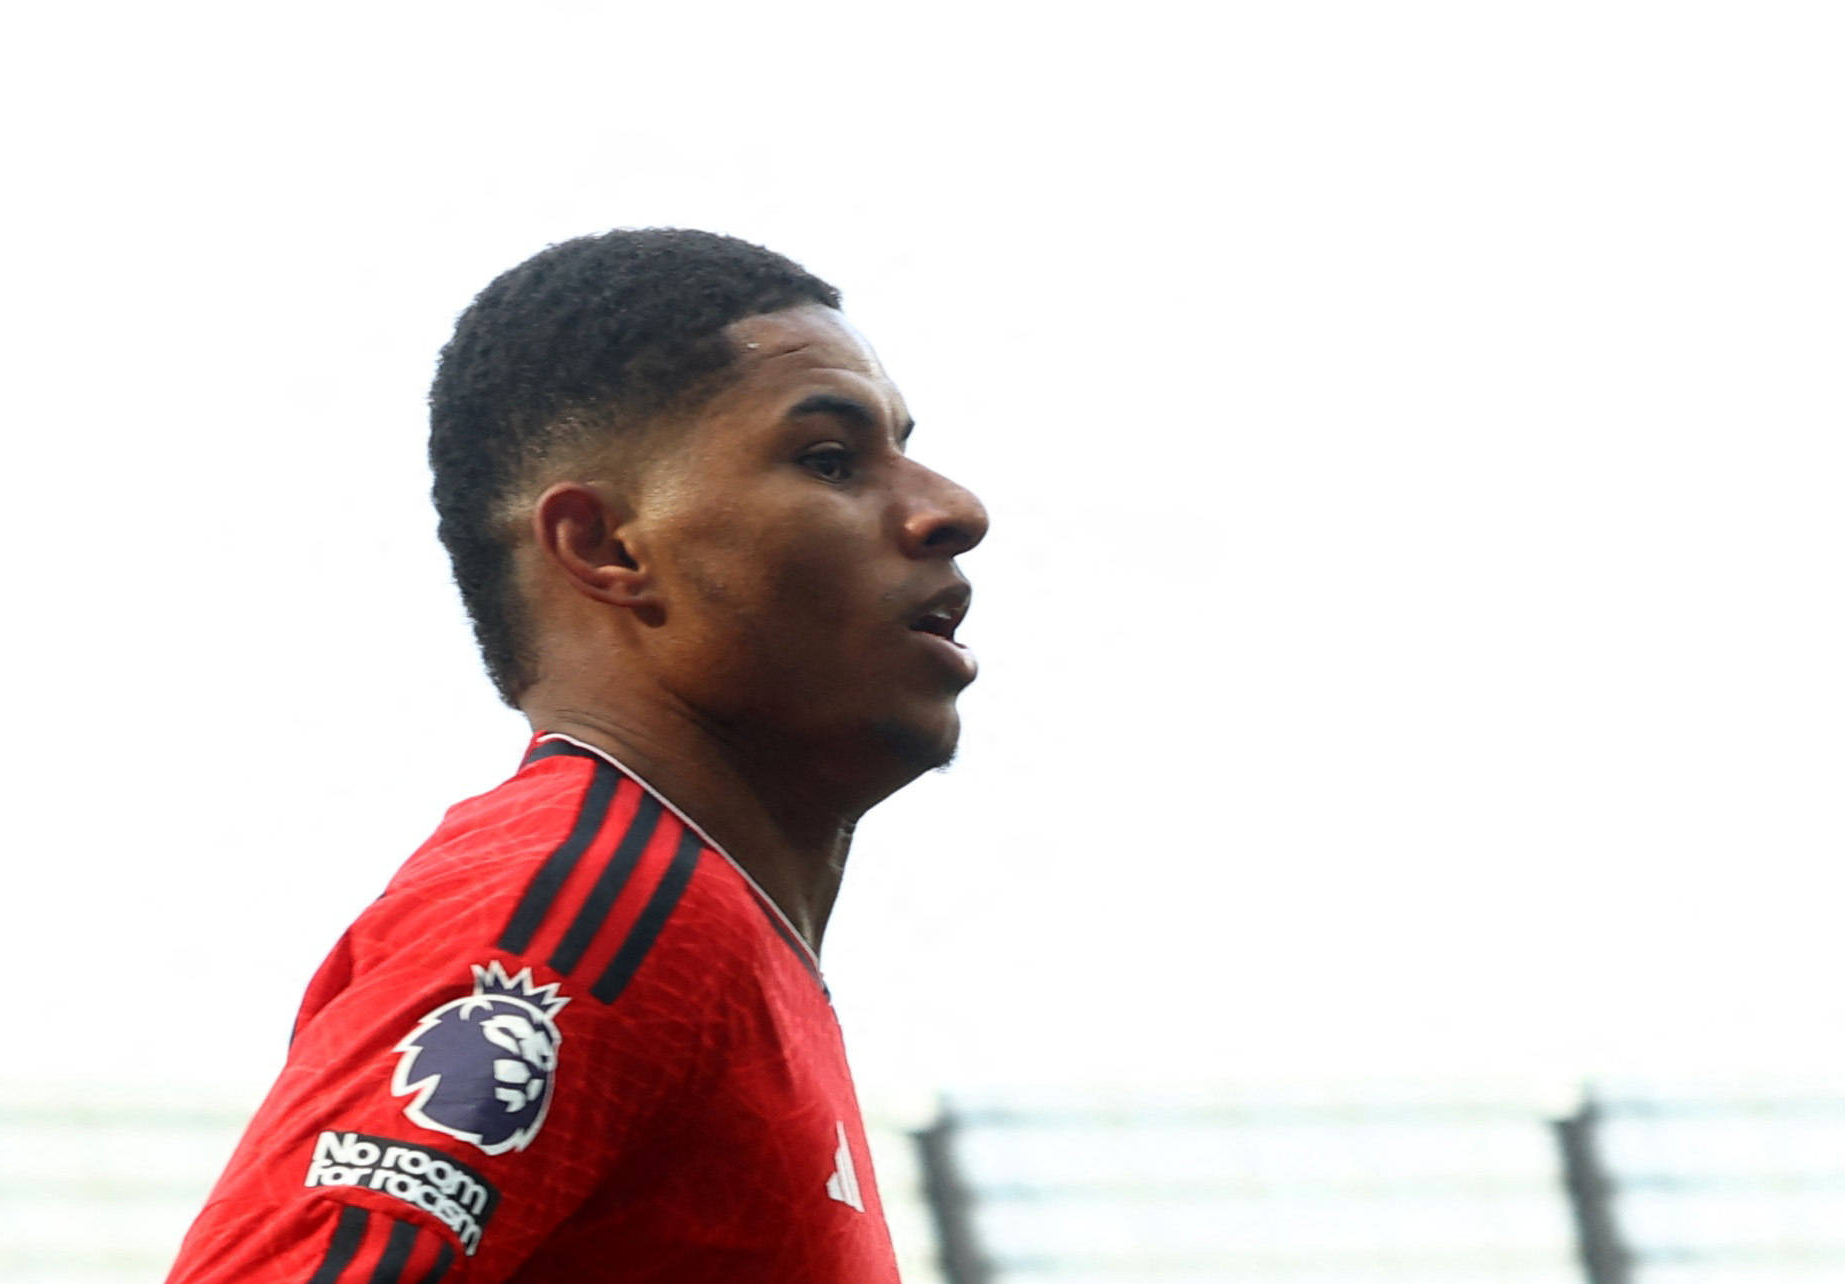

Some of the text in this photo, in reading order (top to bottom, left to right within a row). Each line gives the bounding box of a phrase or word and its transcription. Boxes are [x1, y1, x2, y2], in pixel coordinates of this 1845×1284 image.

[304, 1159, 482, 1256] for racism
[311, 1131, 488, 1215] No room
